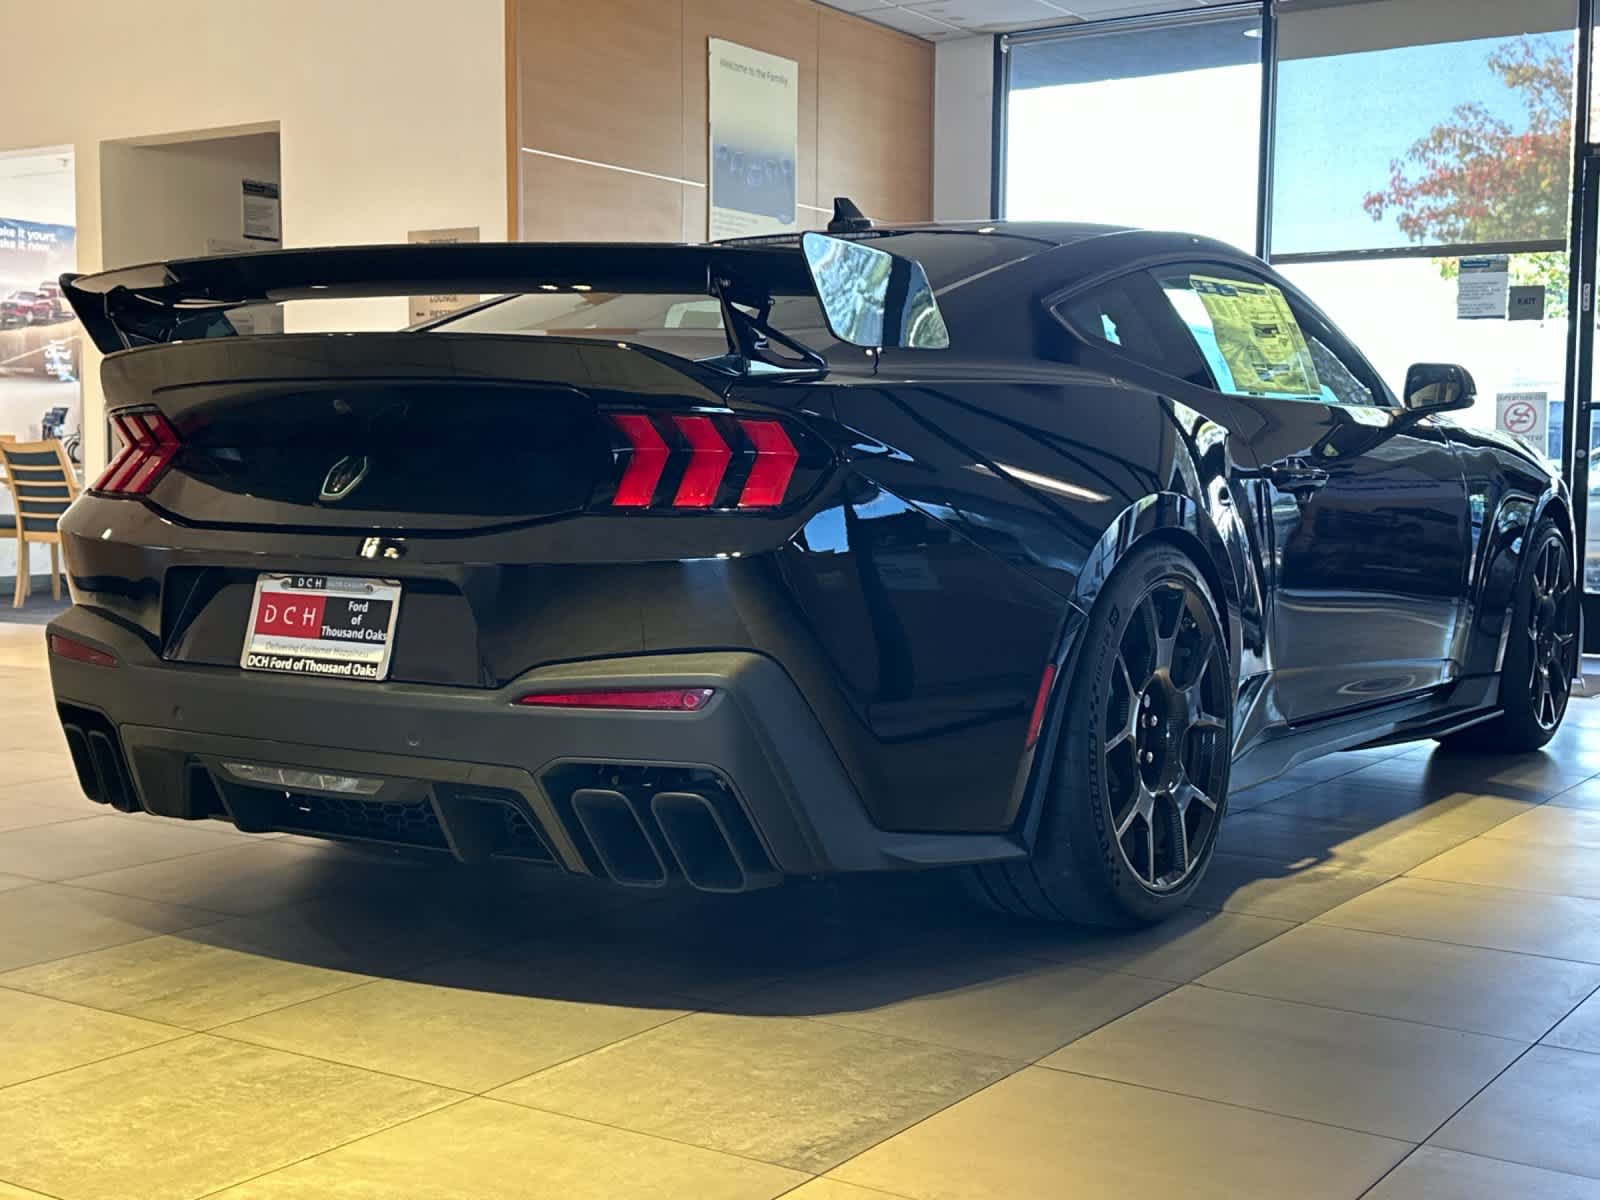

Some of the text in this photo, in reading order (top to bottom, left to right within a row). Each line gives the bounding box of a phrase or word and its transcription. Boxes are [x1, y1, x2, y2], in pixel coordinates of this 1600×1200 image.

[0, 225, 17, 238] ake
[1517, 296, 1537, 305] EXIT
[297, 577, 322, 587] DCH
[348, 601, 369, 613] Ford
[264, 604, 317, 627] DCH
[350, 614, 362, 625] of
[320, 625, 387, 641] Thousand Oaks
[247, 655, 377, 677] DCH Ford of Thousand Oaks
